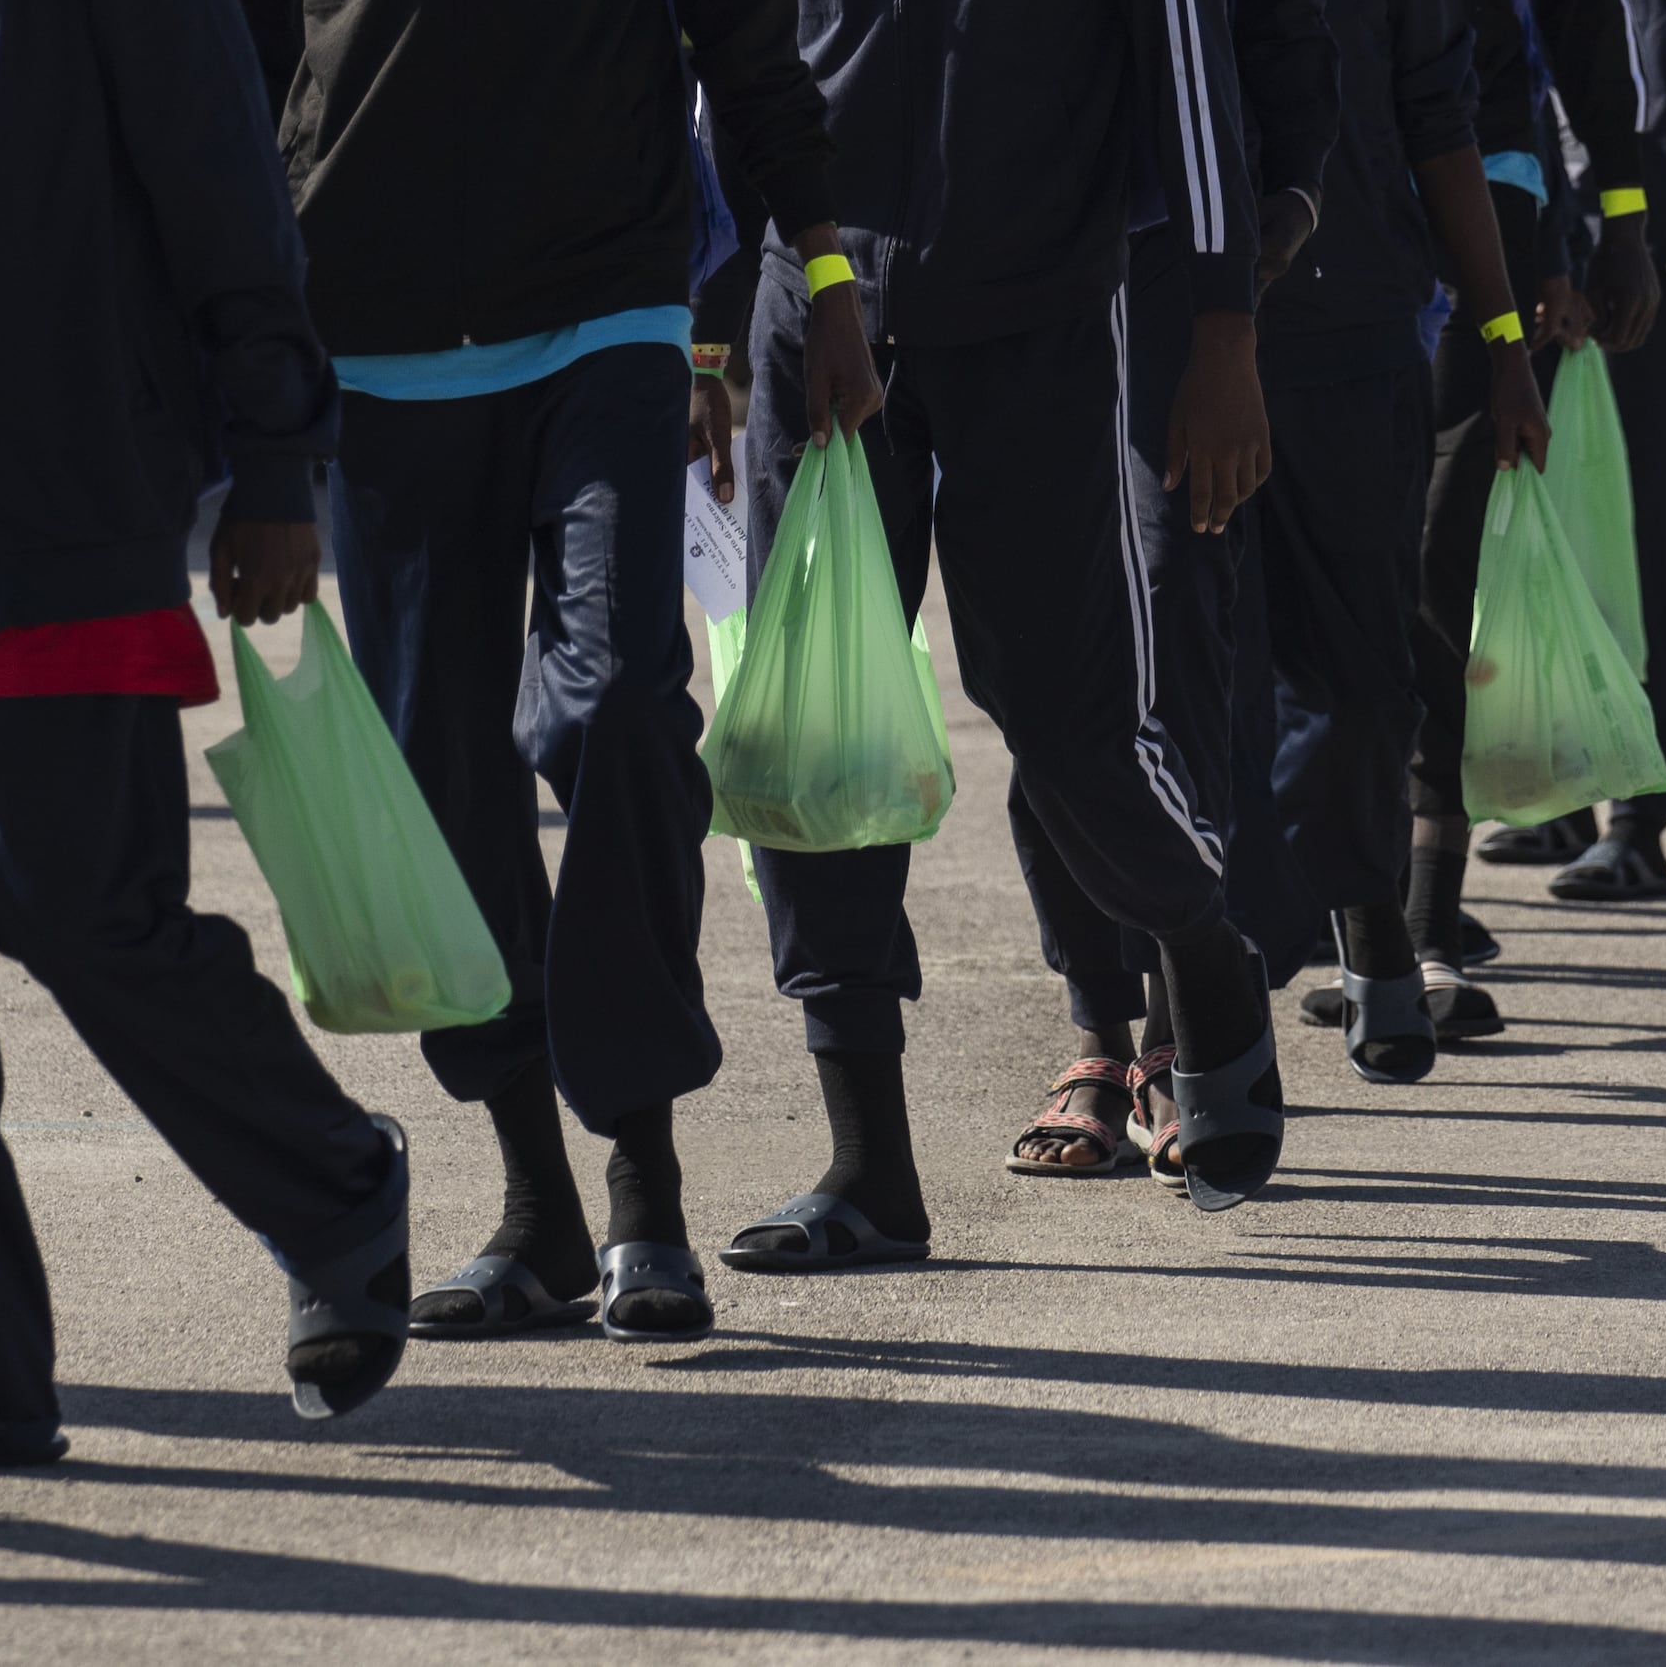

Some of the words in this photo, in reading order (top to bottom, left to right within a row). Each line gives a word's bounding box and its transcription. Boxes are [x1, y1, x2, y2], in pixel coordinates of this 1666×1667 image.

[704, 502, 727, 532] Salerno
[700, 538, 709, 548] DI
[723, 531, 732, 541] di
[734, 527, 748, 543] del
[728, 539, 746, 561] Porto
[707, 548, 737, 590] QUESTURA
